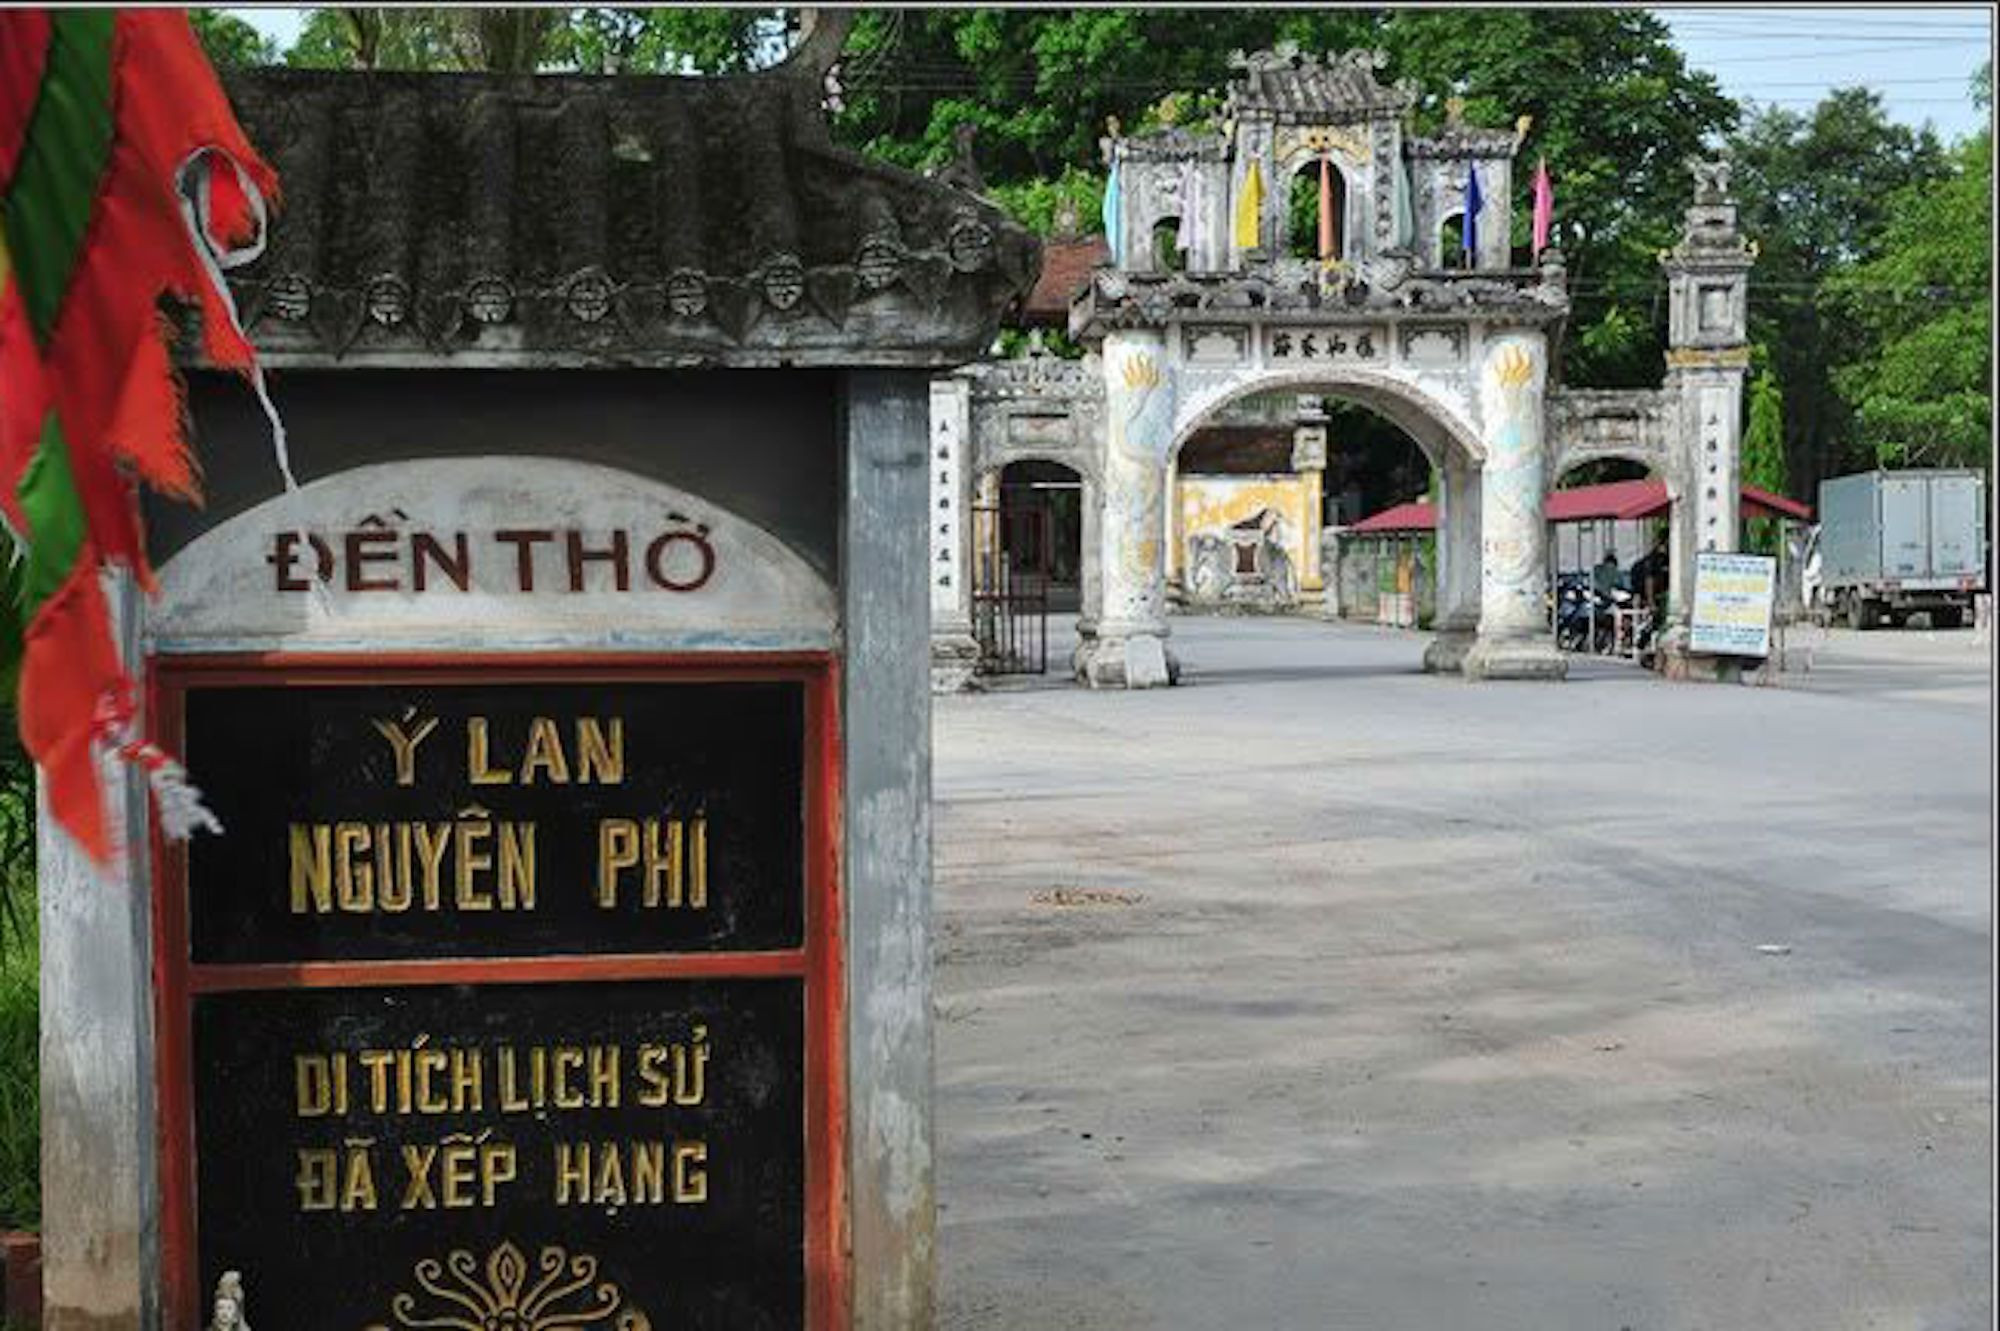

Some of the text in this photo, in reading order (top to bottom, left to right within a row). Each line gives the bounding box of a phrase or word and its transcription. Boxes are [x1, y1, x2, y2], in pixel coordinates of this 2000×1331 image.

[267, 508, 716, 592] ĐỀN THỜ
[466, 715, 625, 785] LAN
[288, 803, 537, 914] NGUYÊN
[294, 1024, 711, 1121] DI TÍCH LỊCH SỬ
[294, 1127, 709, 1217] ĐÃ XẾP HẠNG
